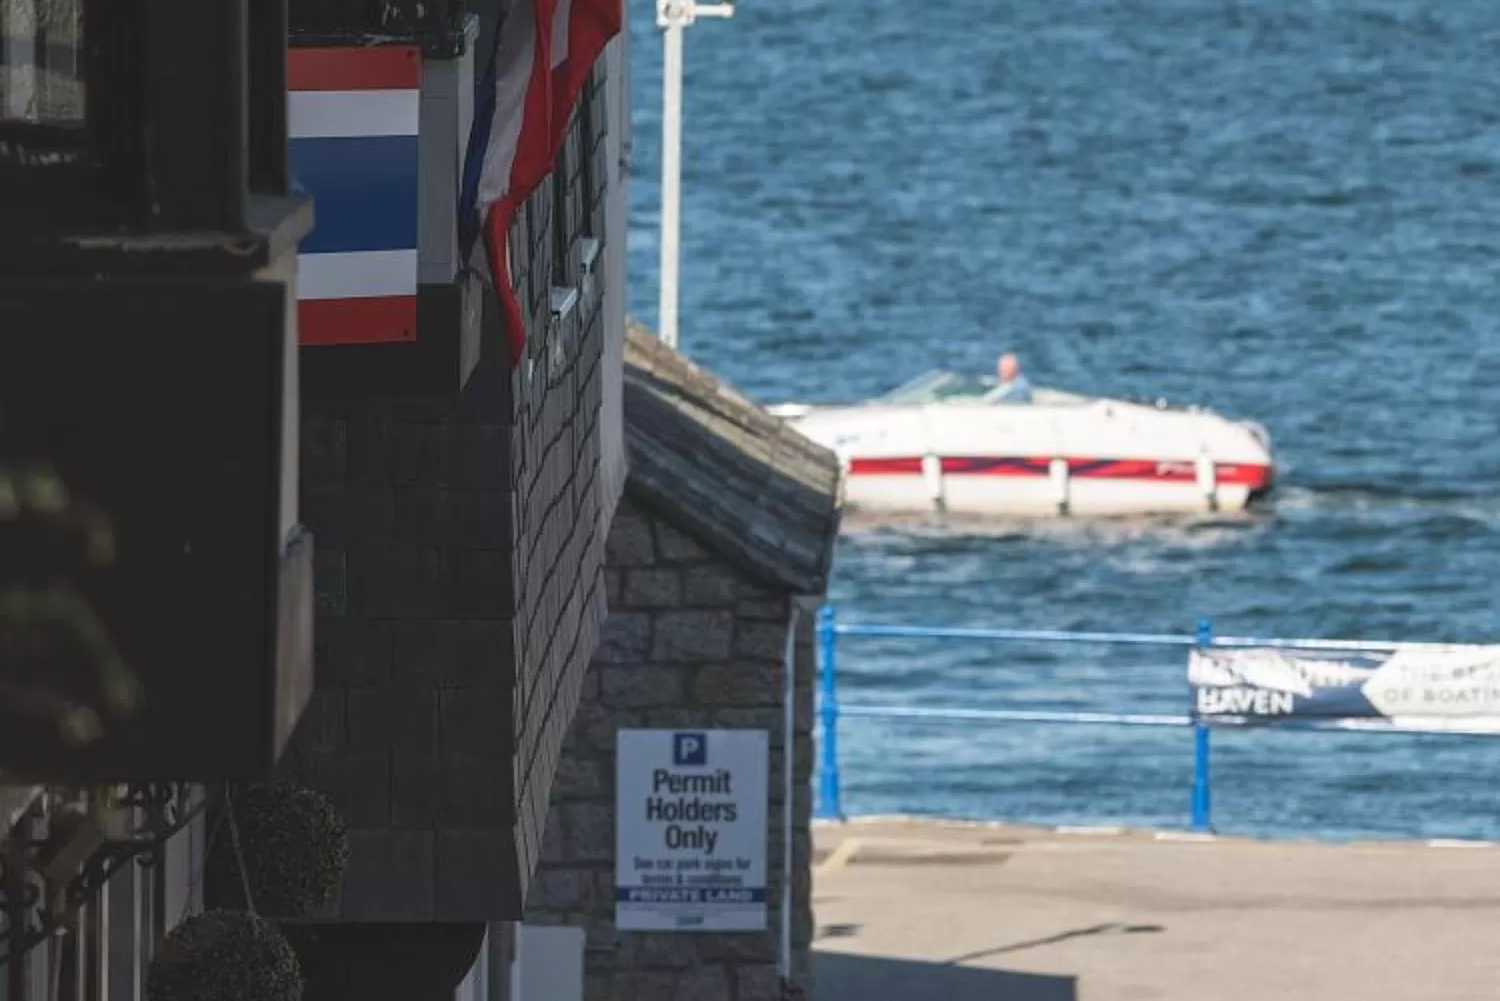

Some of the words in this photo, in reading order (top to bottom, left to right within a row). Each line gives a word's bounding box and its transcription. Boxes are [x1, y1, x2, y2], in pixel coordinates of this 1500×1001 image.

[1198, 687, 1294, 715] HAVEN
[1383, 686, 1413, 704] OF
[680, 737, 699, 760] P
[653, 768, 731, 793] Permit
[646, 797, 737, 822] Holders
[665, 824, 718, 854] Only
